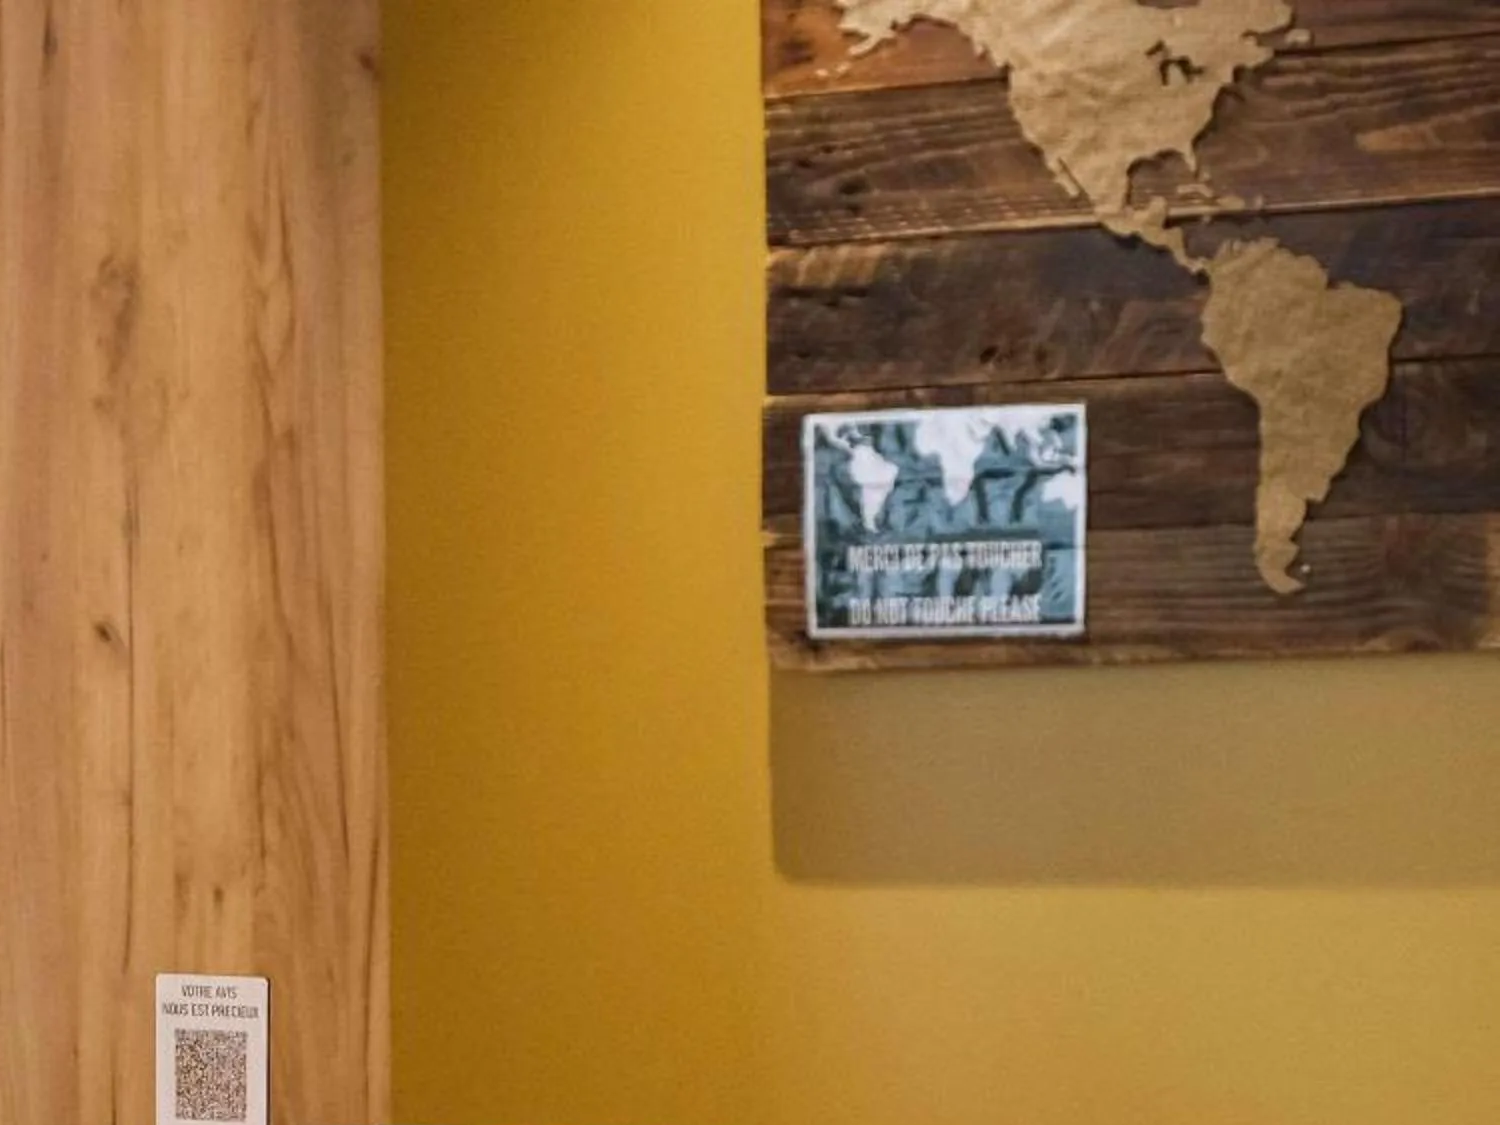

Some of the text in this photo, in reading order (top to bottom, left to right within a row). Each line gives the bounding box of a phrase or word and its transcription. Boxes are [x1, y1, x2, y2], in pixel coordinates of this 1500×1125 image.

[181, 984, 239, 1000] VOTRE AVIS
[162, 1001, 189, 1017] NOUS
[191, 1003, 210, 1018] EST
